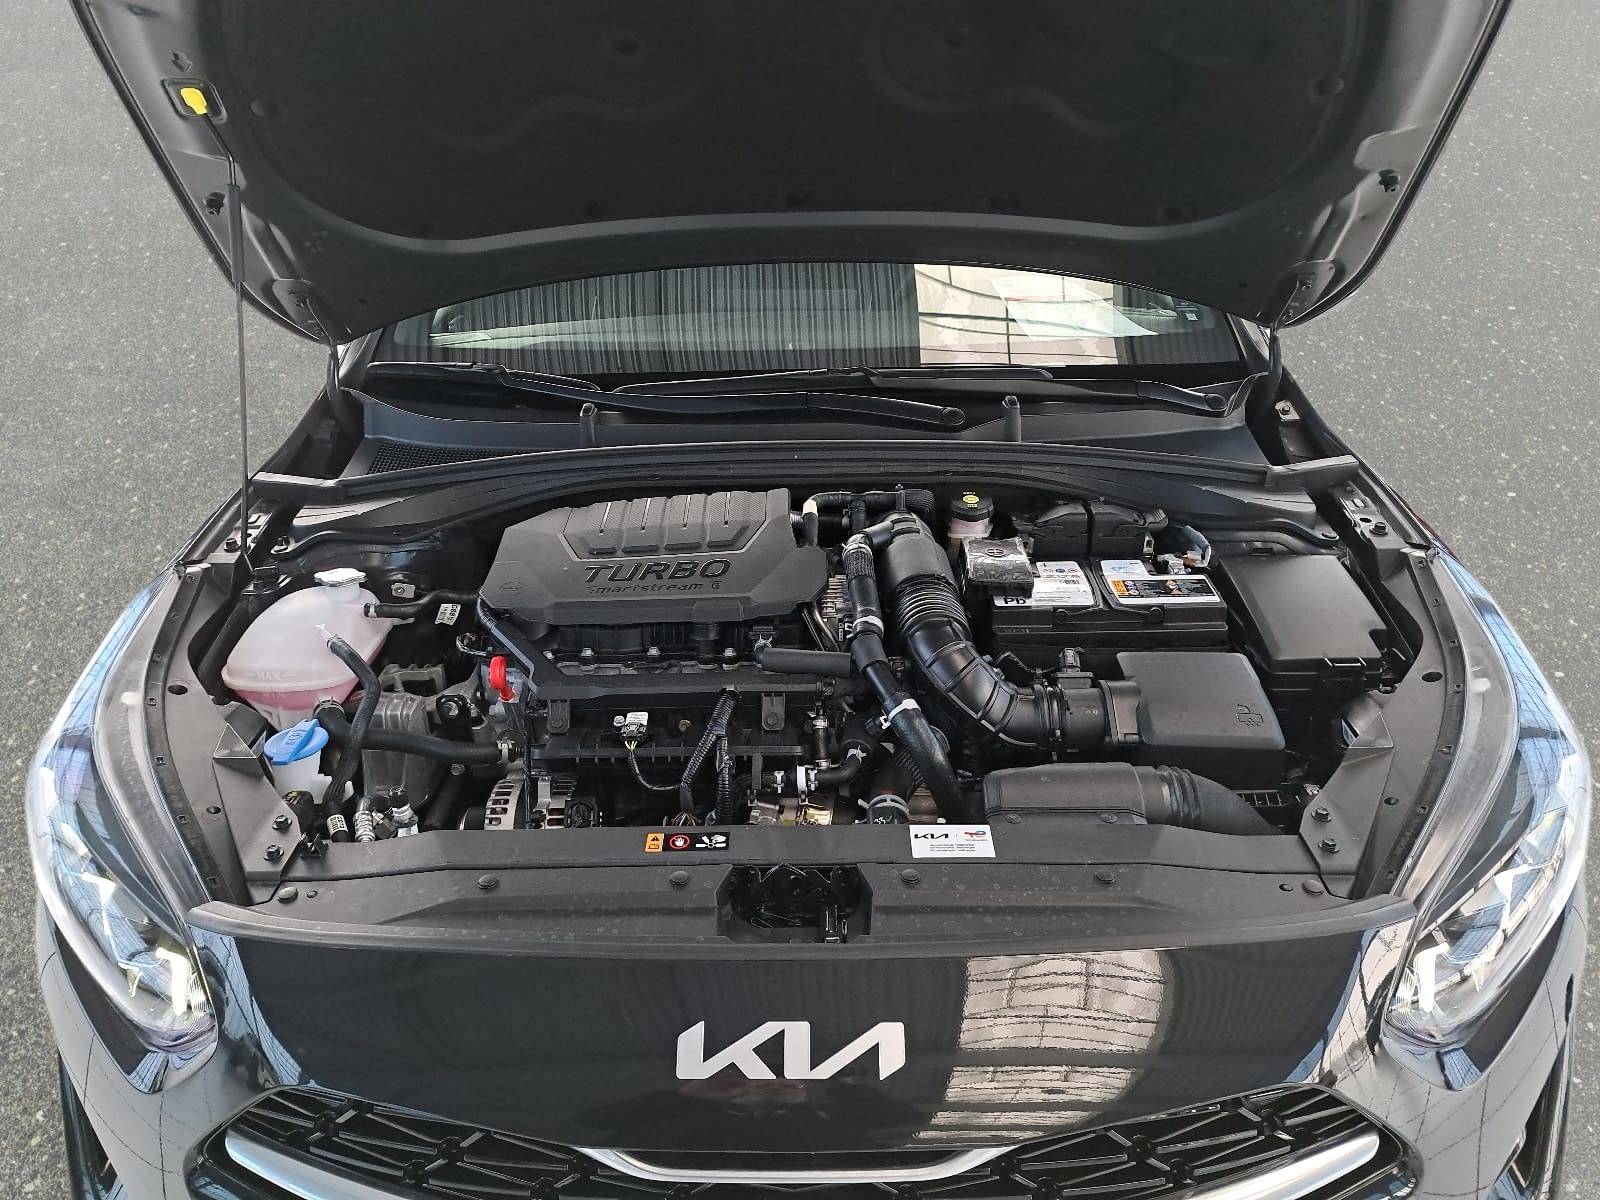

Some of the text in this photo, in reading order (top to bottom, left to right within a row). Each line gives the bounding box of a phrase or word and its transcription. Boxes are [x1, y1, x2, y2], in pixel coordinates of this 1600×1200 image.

[585, 559, 731, 583] TURBO
[586, 583, 704, 594] Smartstream
[256, 671, 280, 681] MAX
[677, 1020, 905, 1080] KIA
